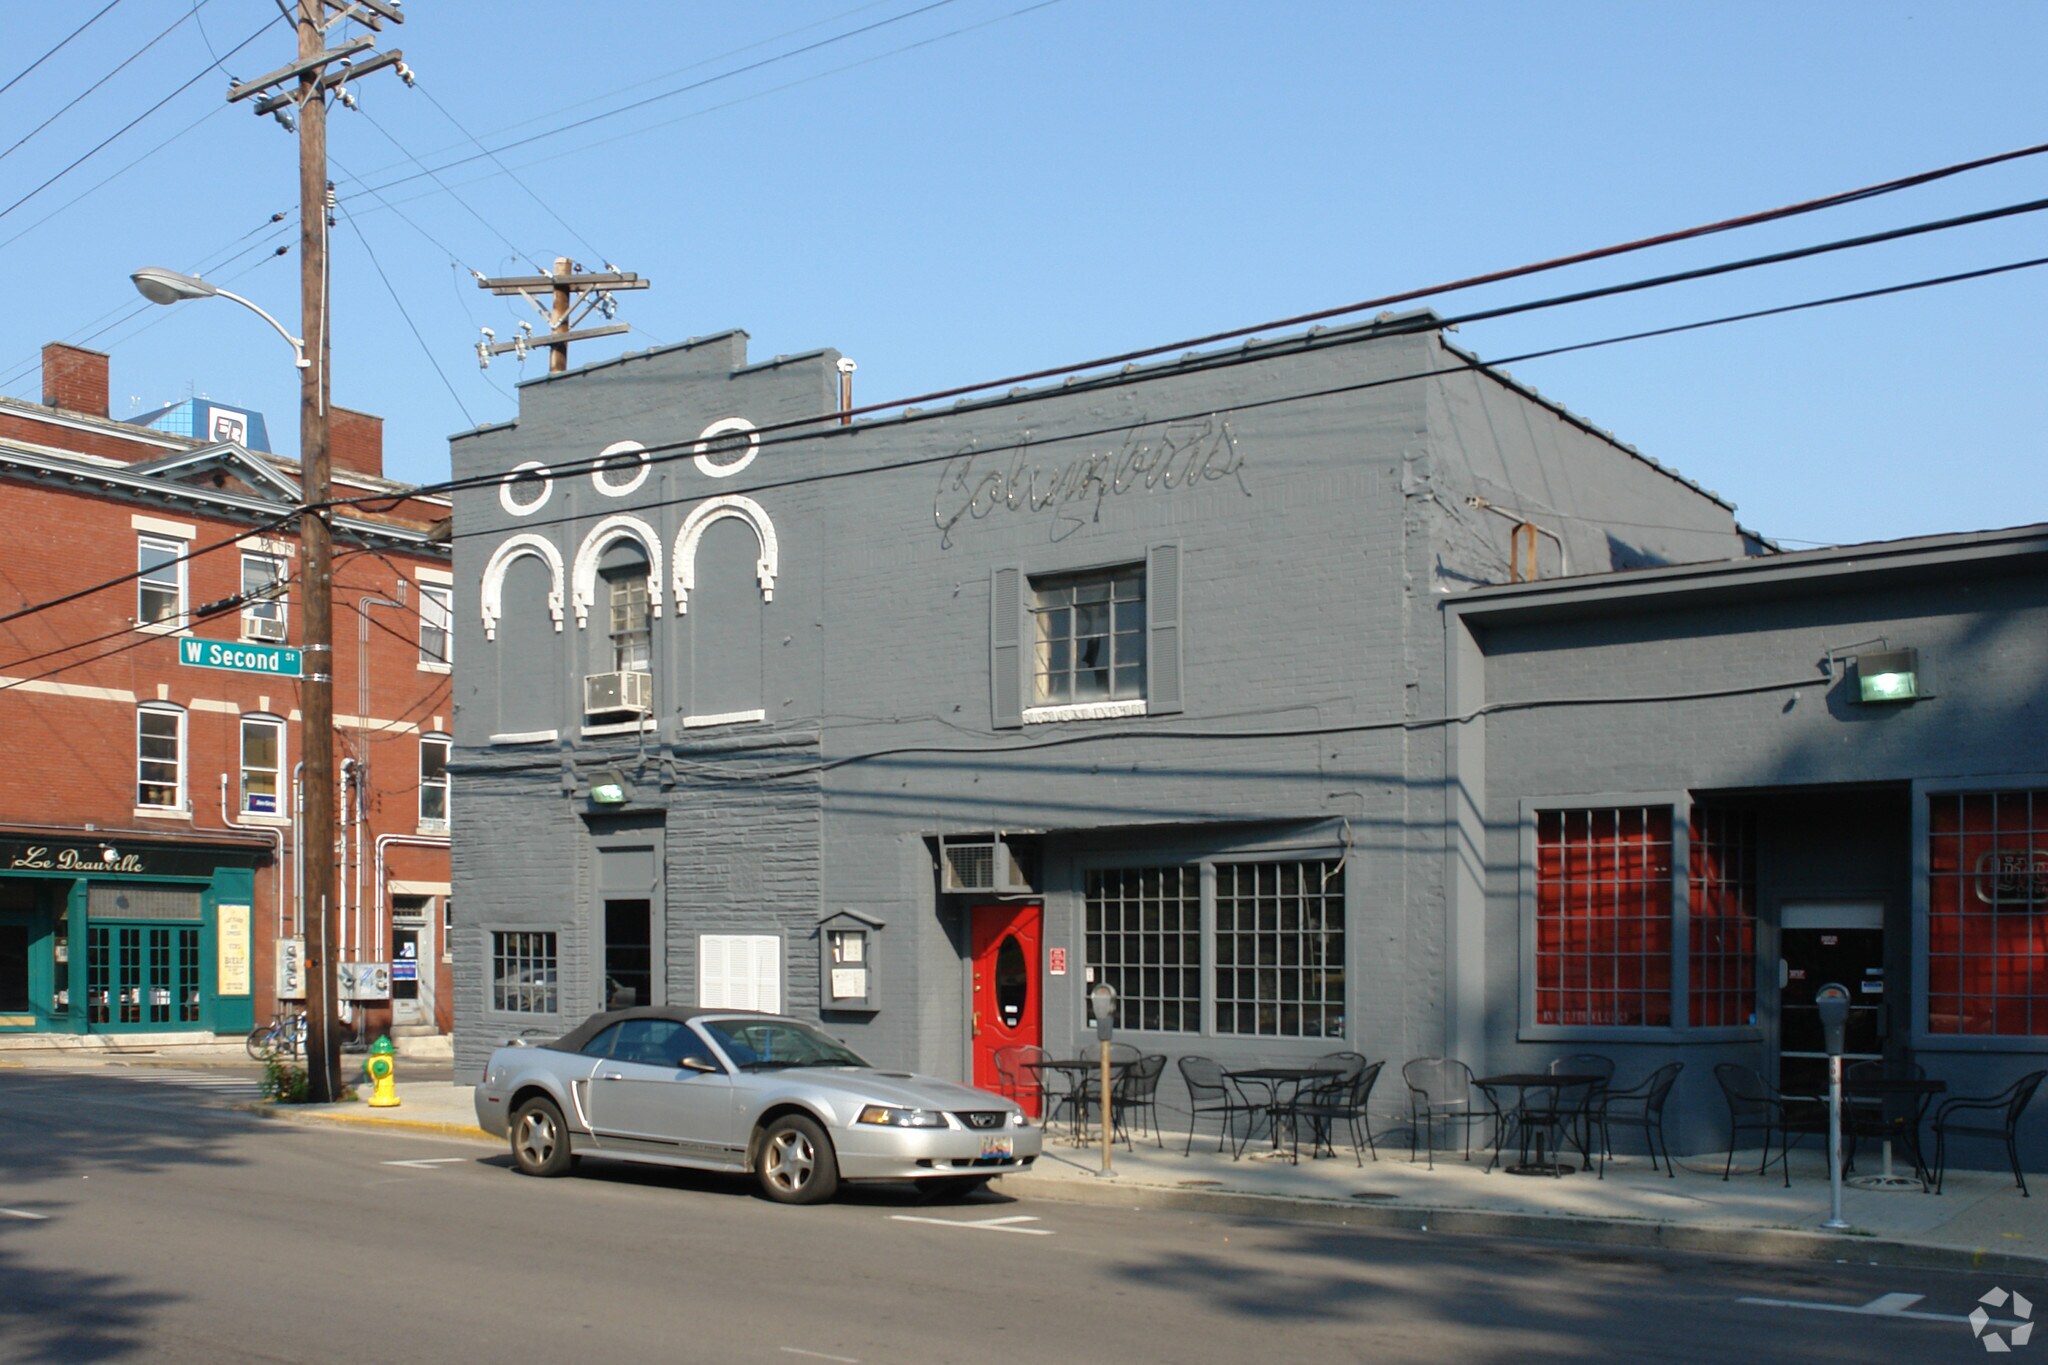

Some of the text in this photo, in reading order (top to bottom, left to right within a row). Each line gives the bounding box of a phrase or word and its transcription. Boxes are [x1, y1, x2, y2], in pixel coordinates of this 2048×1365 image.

[186, 641, 295, 671] W Second St
[14, 845, 144, 872] Le Deauville
